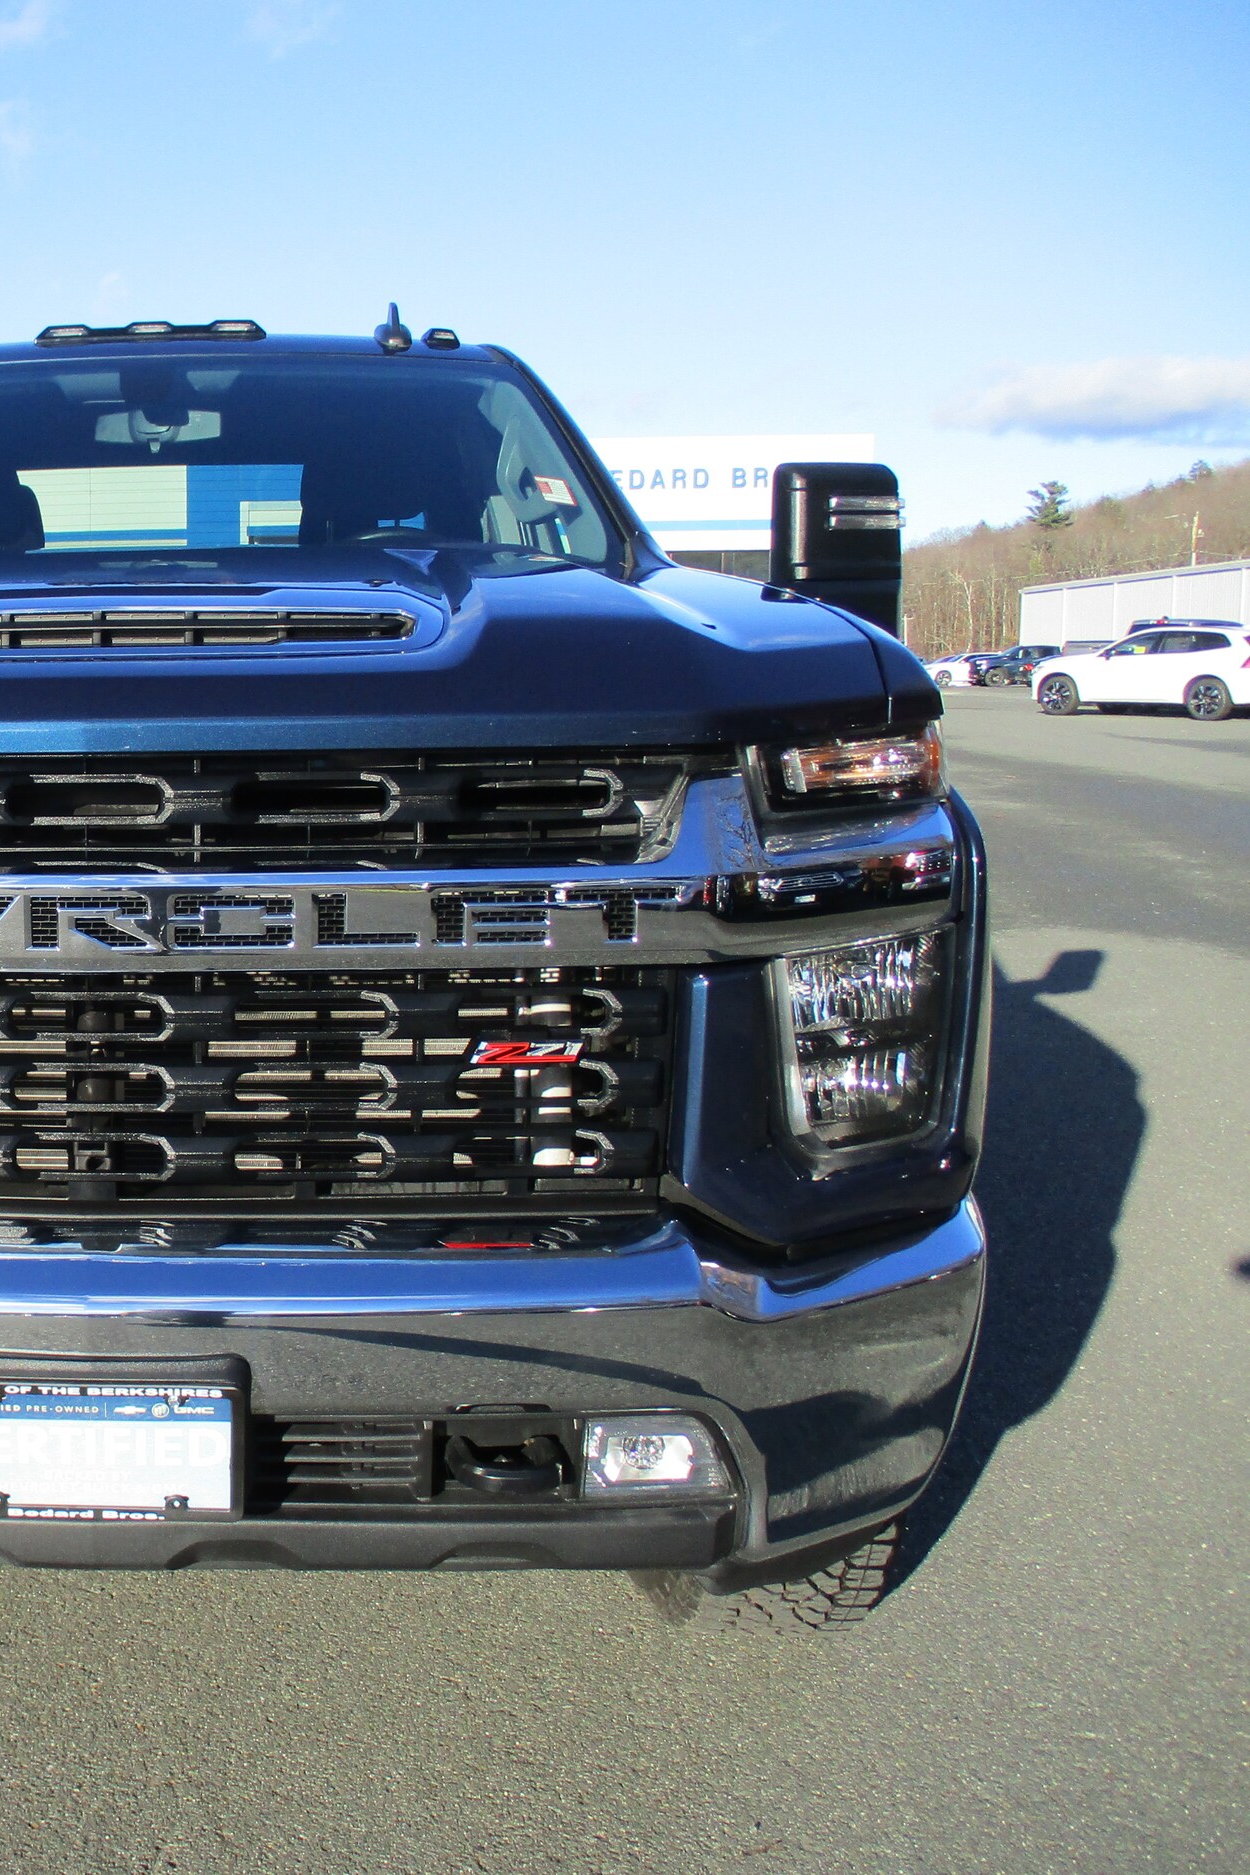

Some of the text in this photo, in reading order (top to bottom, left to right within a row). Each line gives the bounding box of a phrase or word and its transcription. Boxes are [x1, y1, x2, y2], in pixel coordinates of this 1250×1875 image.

[731, 467, 769, 489] BR
[470, 1041, 584, 1064] Z71
[4, 1384, 32, 1395] OF
[37, 1386, 81, 1396] THE
[86, 1387, 223, 1399] BERKSHIRES
[26, 1404, 100, 1414] PRE-OWNED
[173, 1405, 215, 1415] GMC
[102, 1509, 166, 1520] Bros.
